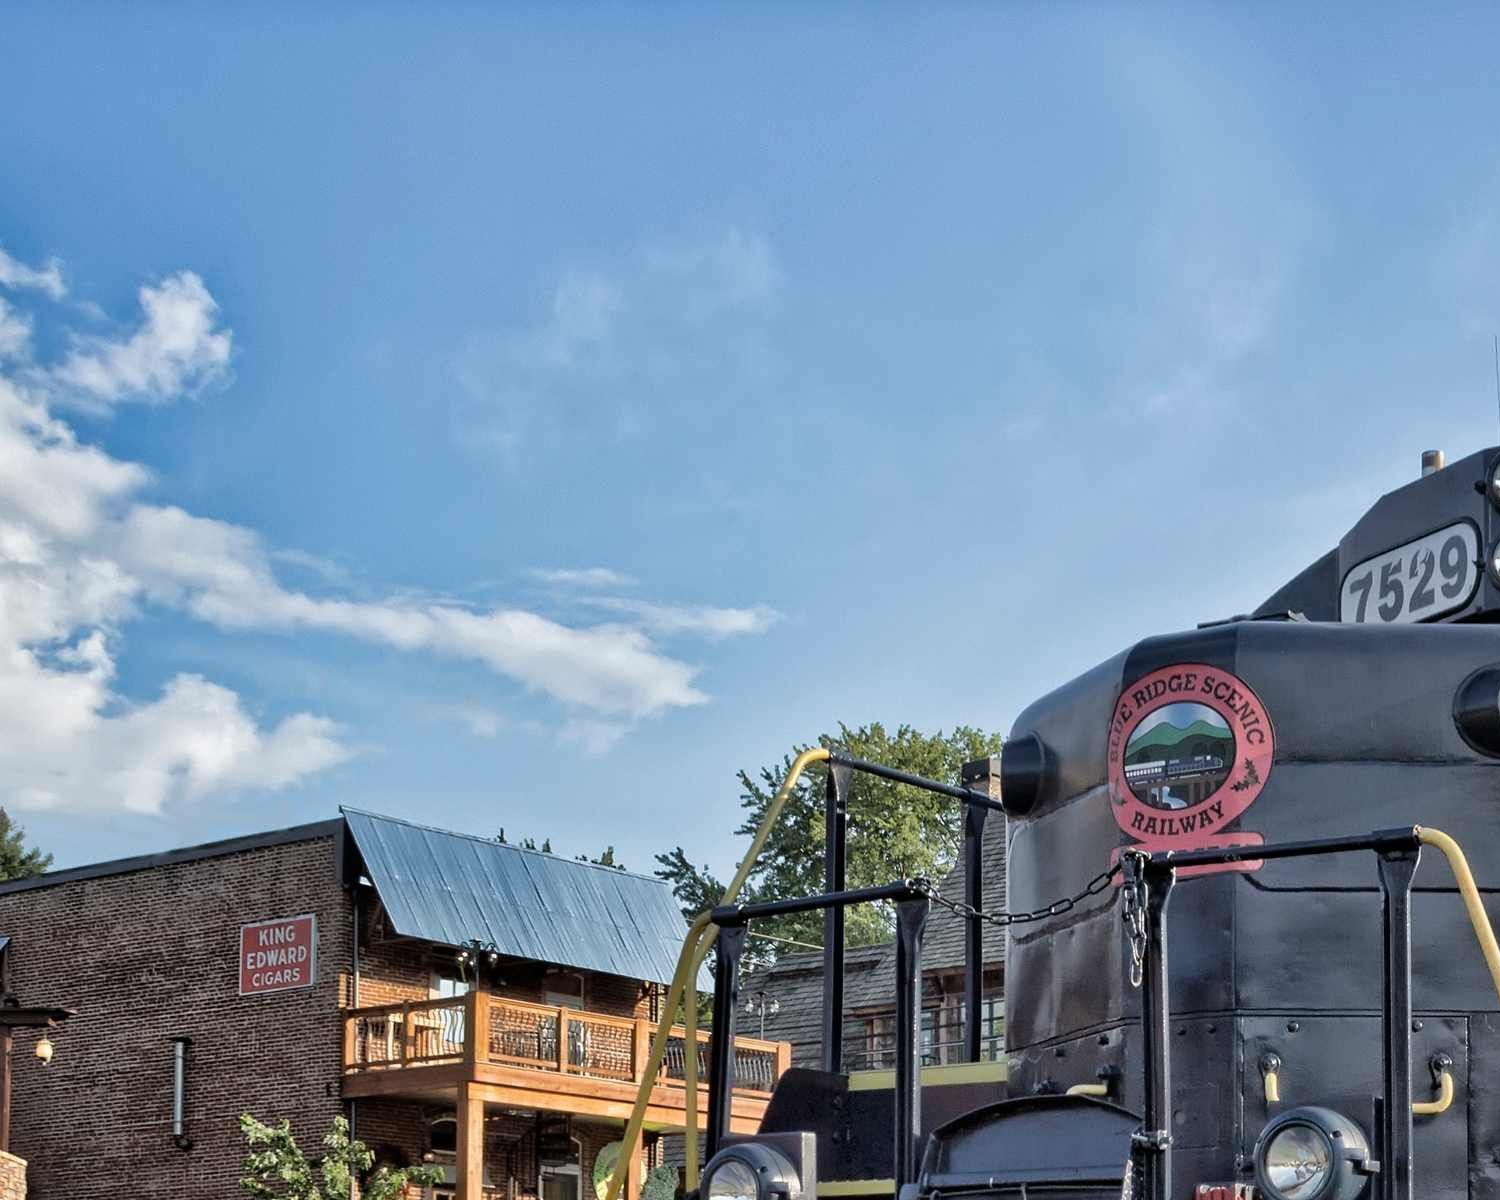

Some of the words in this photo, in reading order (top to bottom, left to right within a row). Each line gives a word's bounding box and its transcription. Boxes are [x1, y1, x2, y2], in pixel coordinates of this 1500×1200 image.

[1349, 535, 1468, 623] 7529
[1110, 701, 1133, 762] BLUE
[1132, 673, 1197, 709] RIDGE
[1200, 675, 1266, 745] SCENIC
[1131, 800, 1225, 836] RAILWAY
[259, 925, 296, 947] KING
[246, 945, 307, 970] EDWARD
[252, 967, 301, 987] CIGARS
